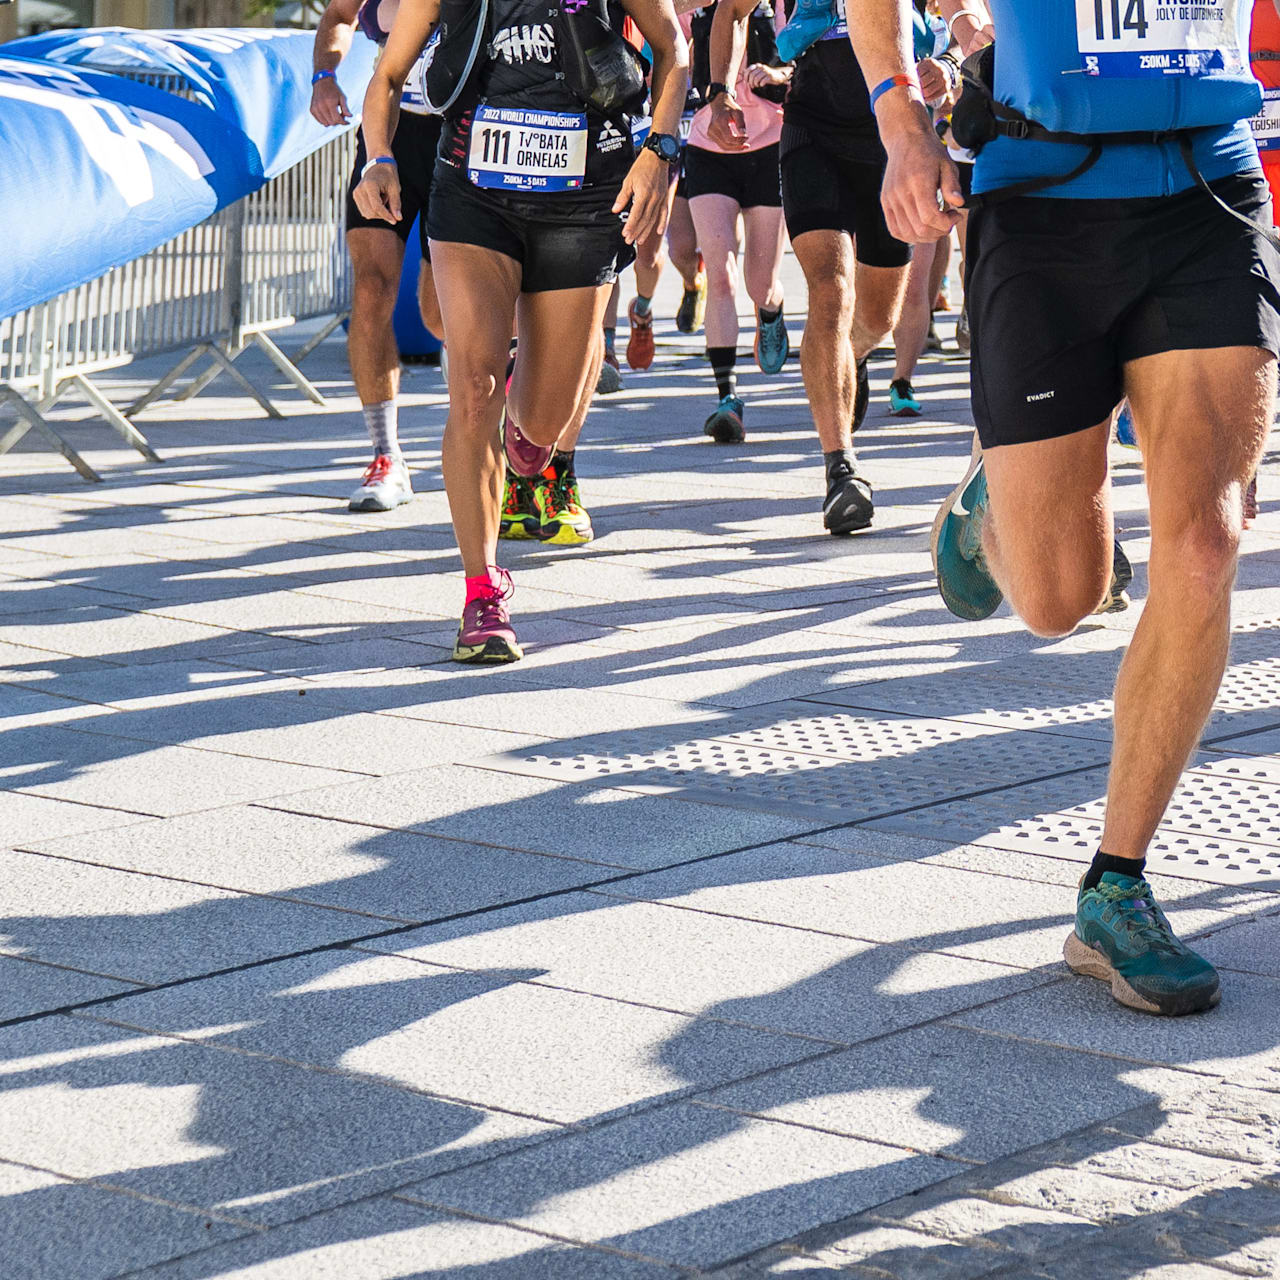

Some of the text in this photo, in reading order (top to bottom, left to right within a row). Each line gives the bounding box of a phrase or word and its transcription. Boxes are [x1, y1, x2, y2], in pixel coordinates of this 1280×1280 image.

[1155, 8, 1176, 21] JOLY
[1179, 7, 1190, 20] DE
[1139, 55, 1170, 69] 250KM
[1178, 55, 1184, 67] 5
[483, 108, 580, 128] 2022 WORLD CHAMPIONSHIPS
[482, 128, 511, 165] 111
[601, 142, 623, 154] MOTORS
[516, 150, 568, 168] ORNELAS
[1026, 390, 1055, 402] EVADICT
